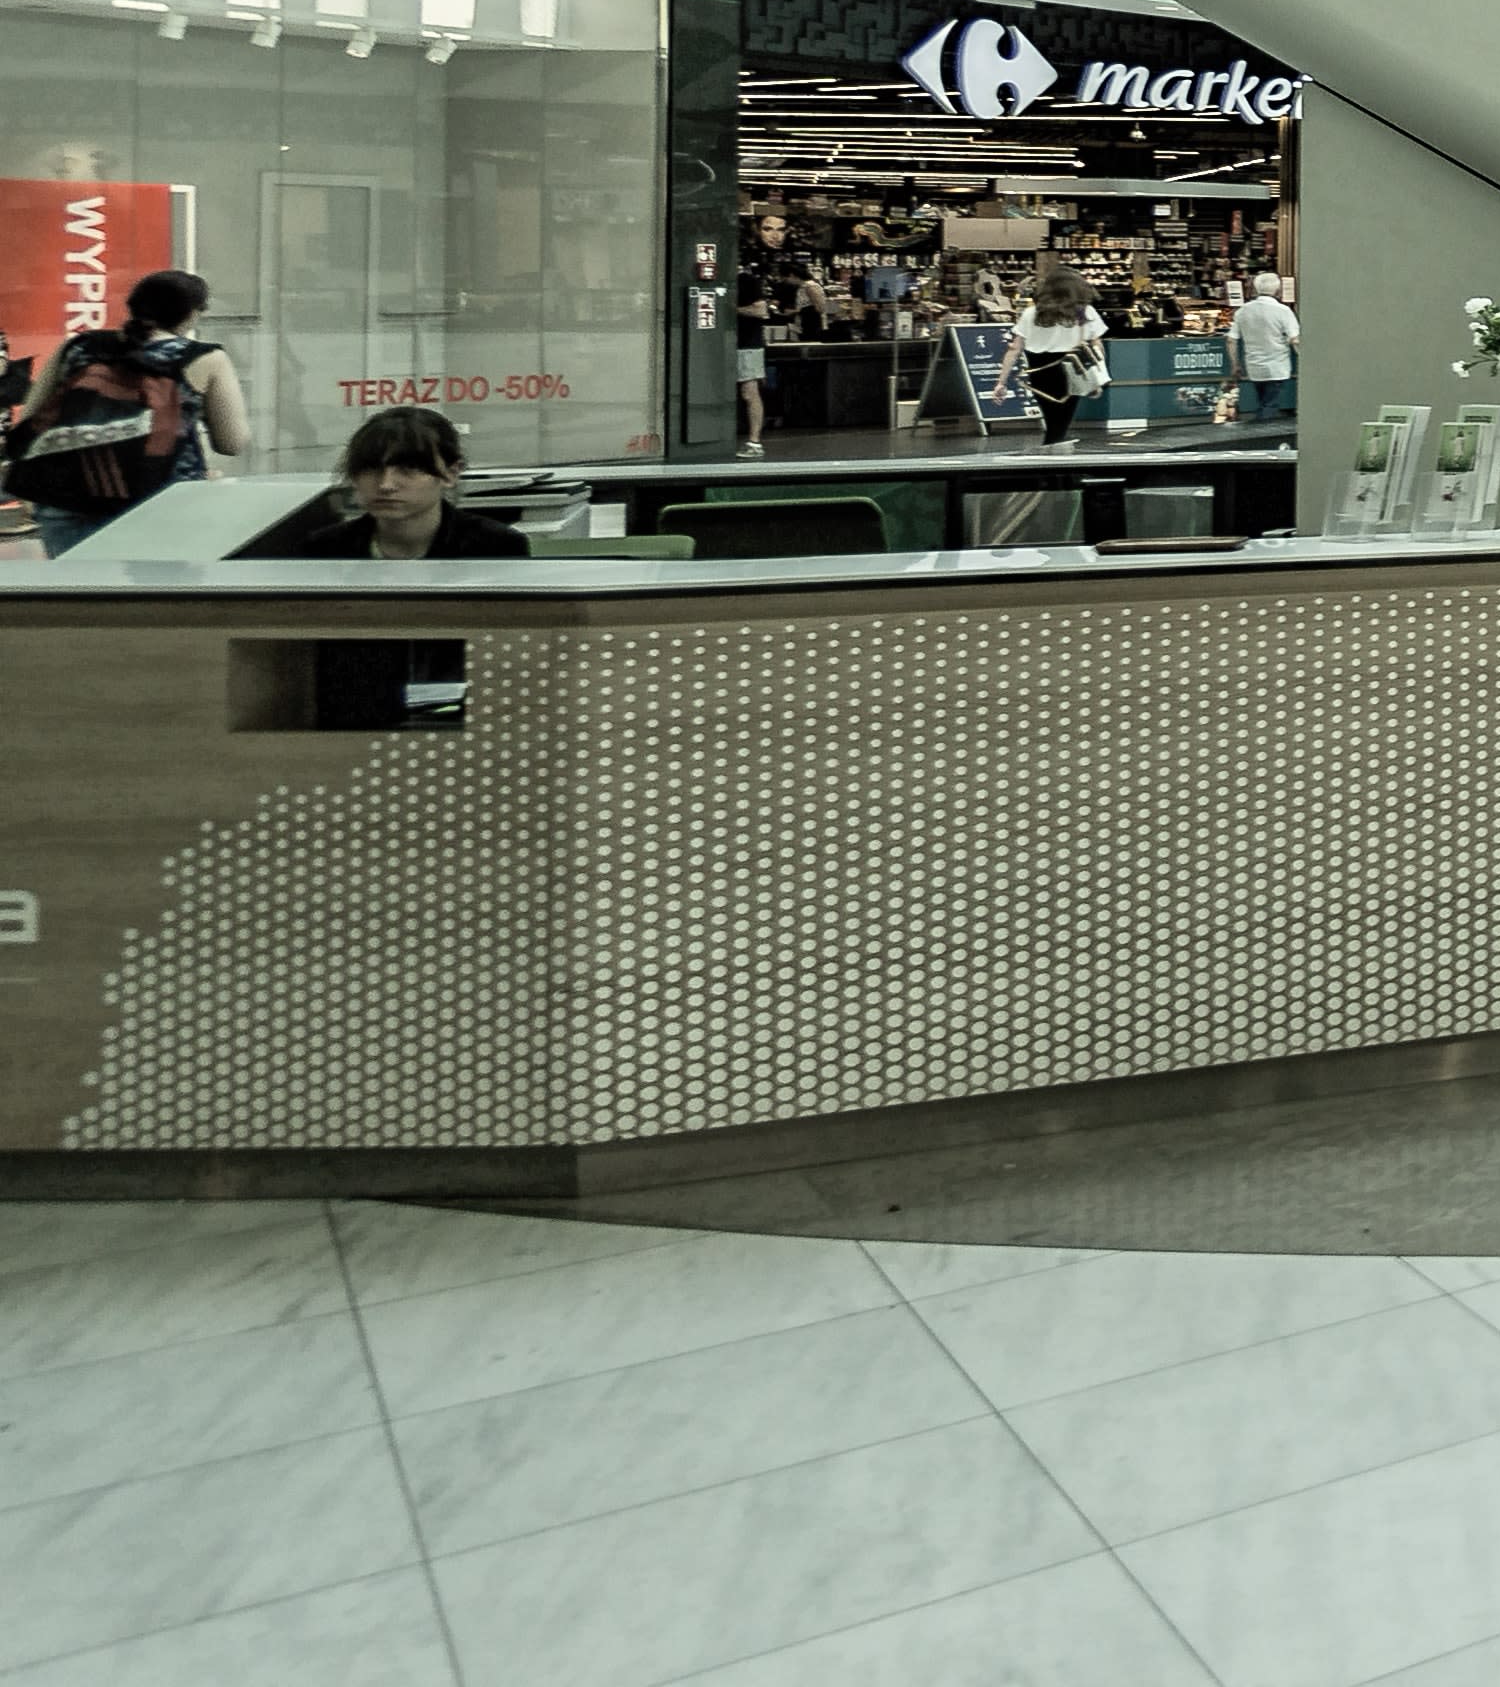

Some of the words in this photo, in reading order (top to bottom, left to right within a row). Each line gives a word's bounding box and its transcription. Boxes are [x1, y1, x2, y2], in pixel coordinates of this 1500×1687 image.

[65, 196, 108, 336] WYPR
[338, 378, 440, 407] TERAZ
[445, 376, 490, 403] DO
[495, 374, 570, 401] -50%
